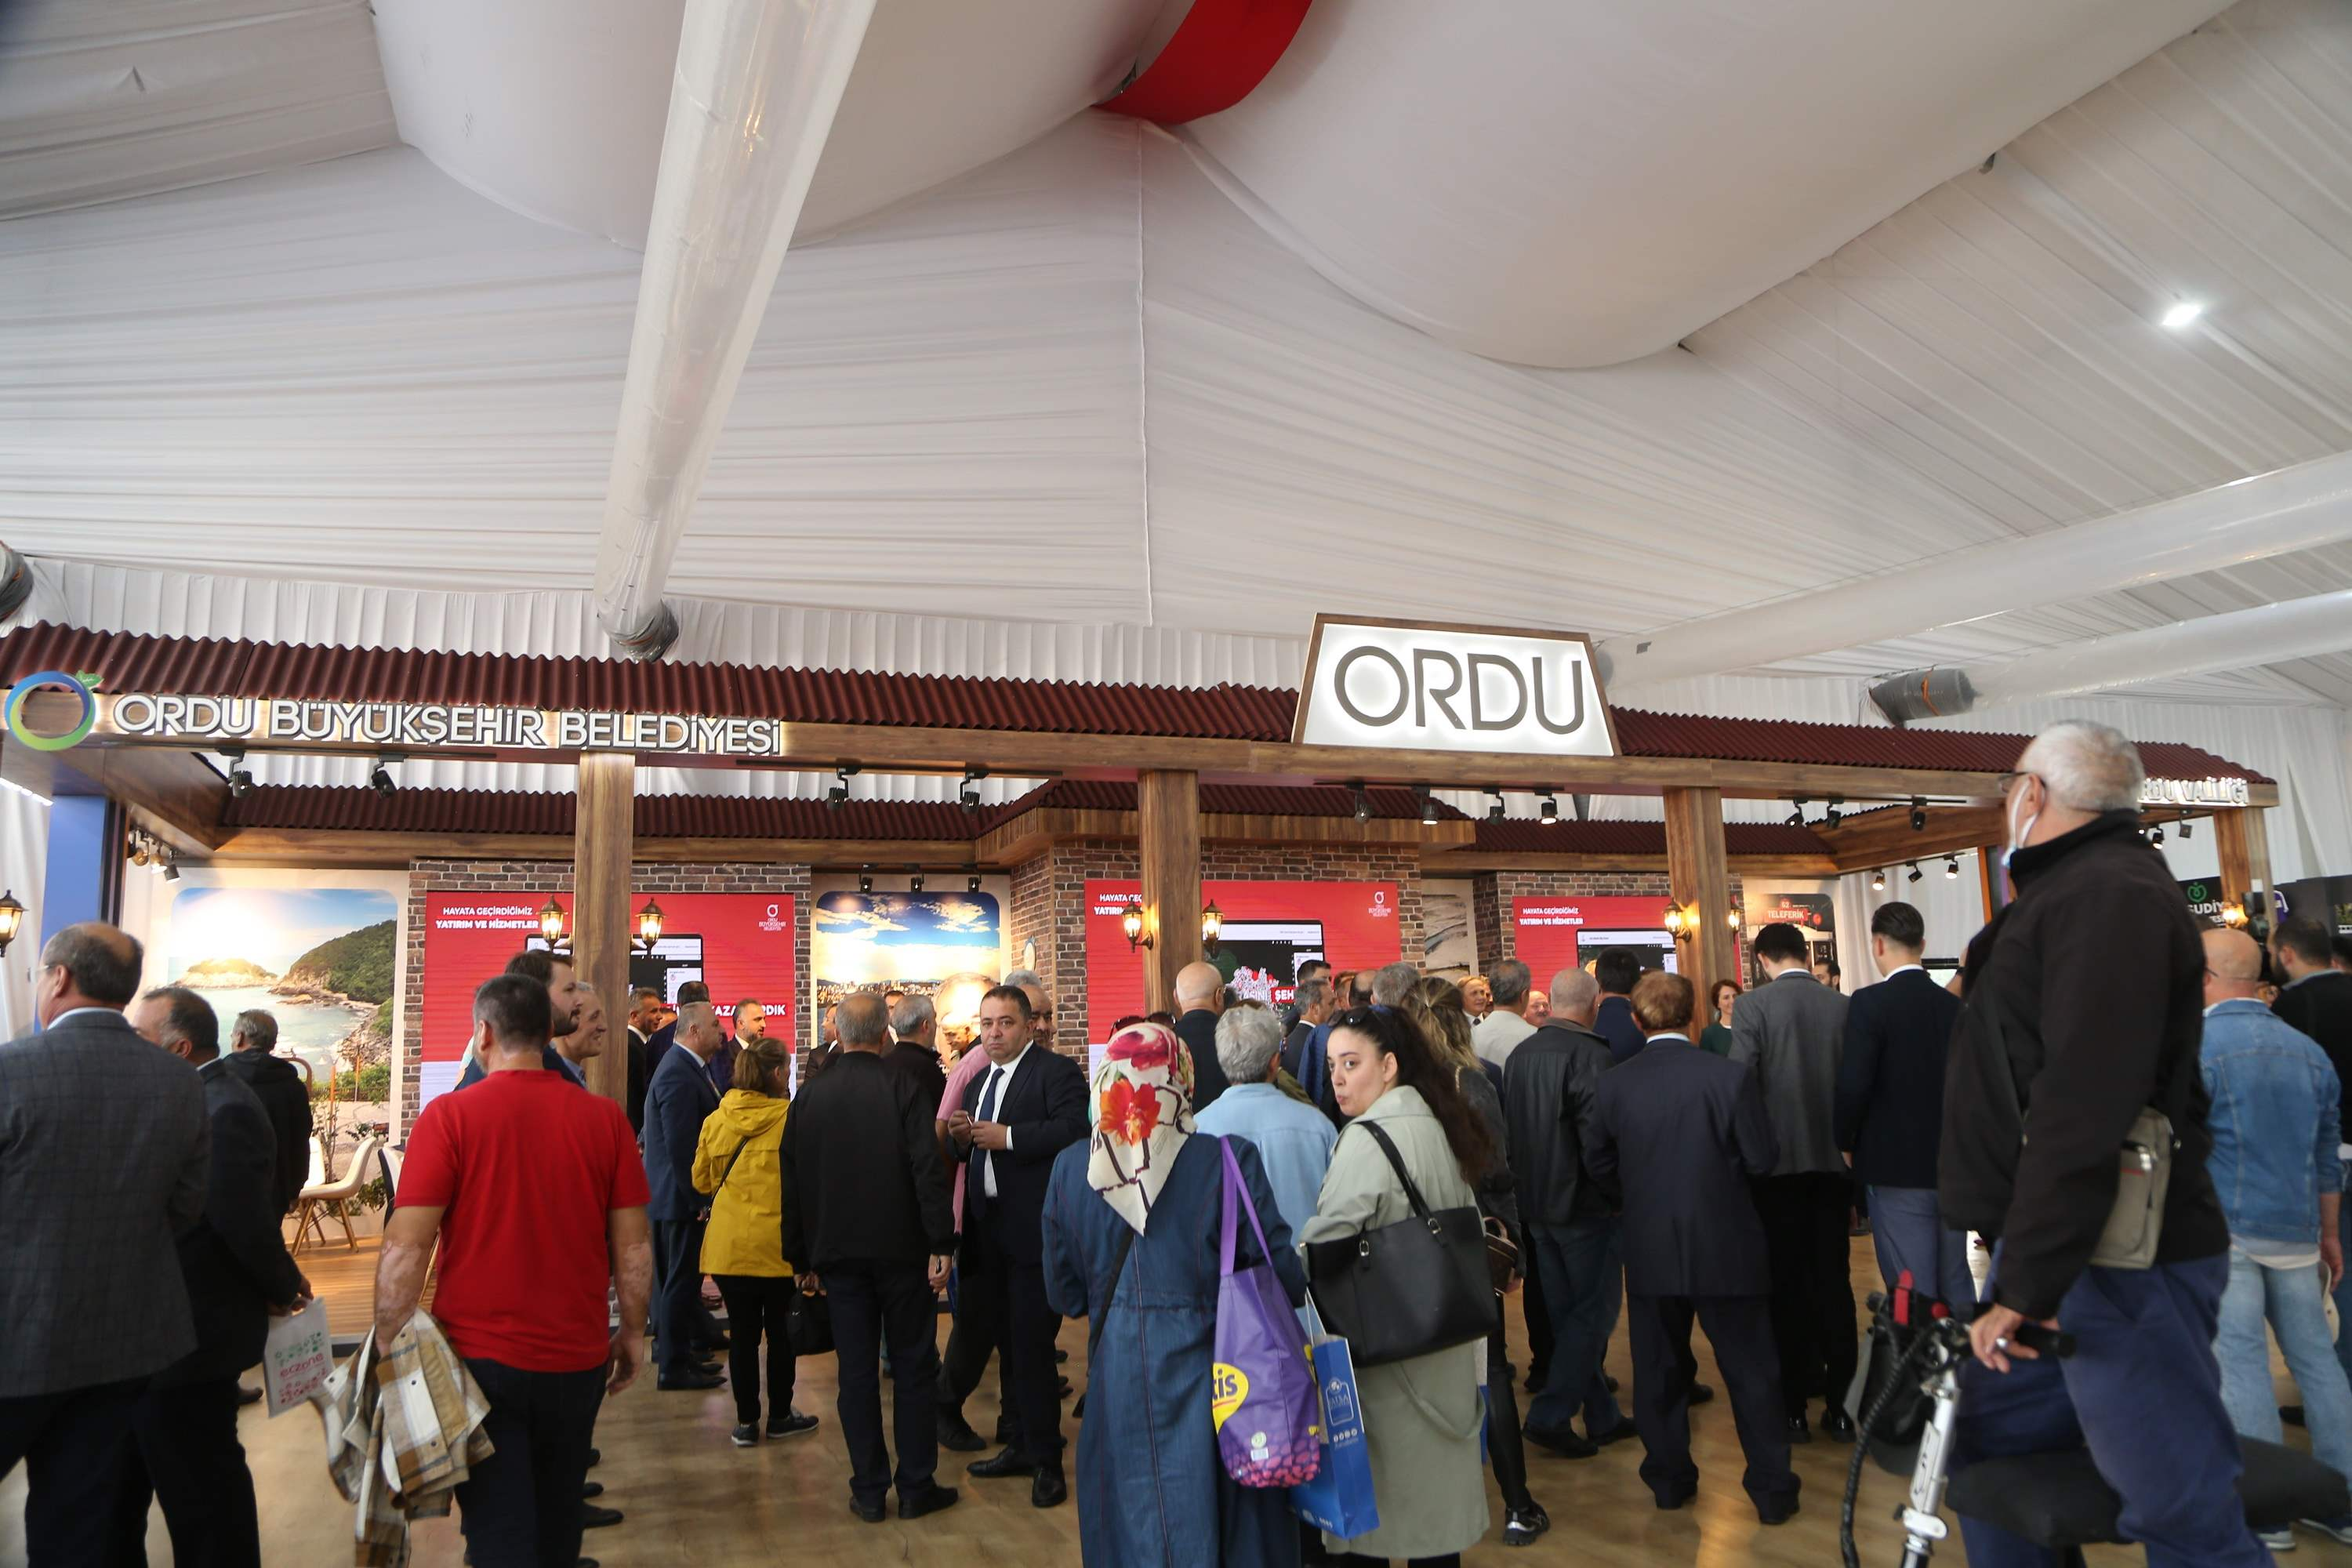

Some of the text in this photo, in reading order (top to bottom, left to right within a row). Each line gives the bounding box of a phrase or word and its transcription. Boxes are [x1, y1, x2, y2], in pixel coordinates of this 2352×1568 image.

[1334, 645, 1585, 735] ORDU
[114, 694, 781, 755] ORDU BÜYÜKŞEHİR BELEDİYESİ
[2140, 778, 2178, 802] RDU
[1099, 894, 1128, 902] HAYATA
[442, 905, 533, 916] HAYATA GEÇİRDİĞİMİZ
[1767, 909, 1805, 920] TELEFERİK
[435, 918, 539, 929] YATIRIM VE HİZMETLER
[281, 1353, 323, 1376] eczone
